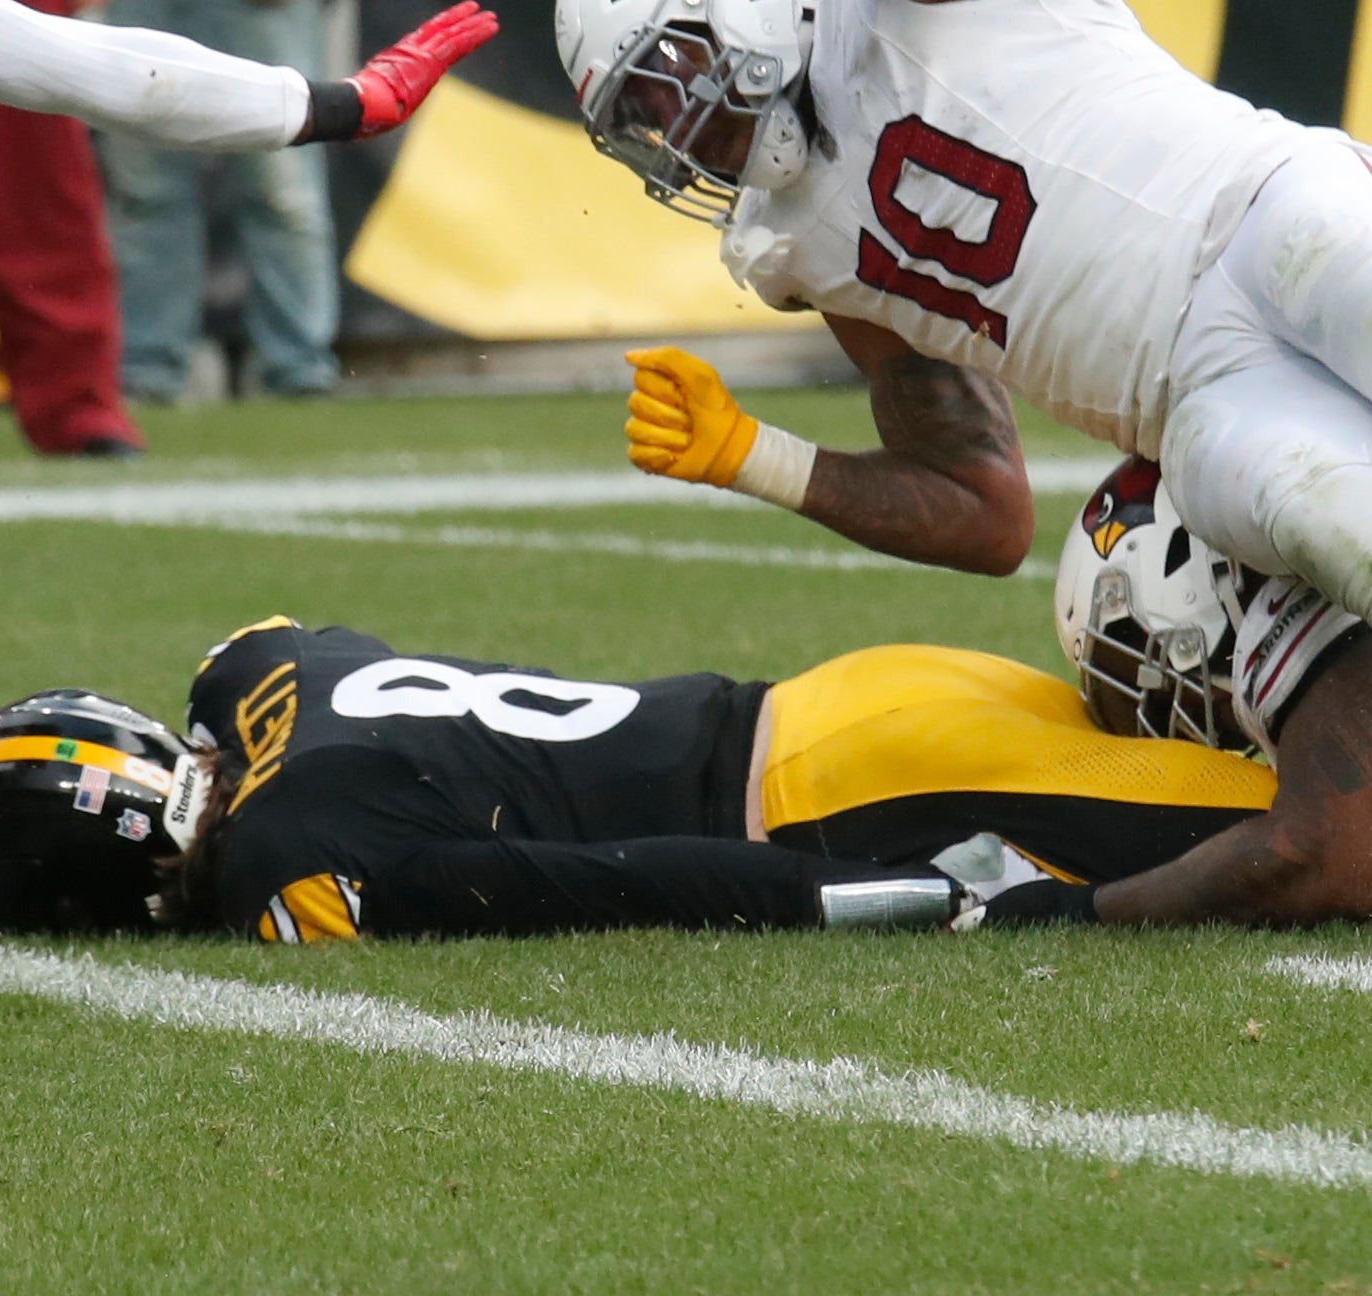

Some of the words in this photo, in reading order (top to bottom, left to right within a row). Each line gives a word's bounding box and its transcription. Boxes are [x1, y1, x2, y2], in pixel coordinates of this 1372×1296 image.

[856, 113, 1038, 351] 10
[331, 657, 642, 743] 8
[123, 754, 174, 793] 8
[171, 763, 199, 825] Steelers
